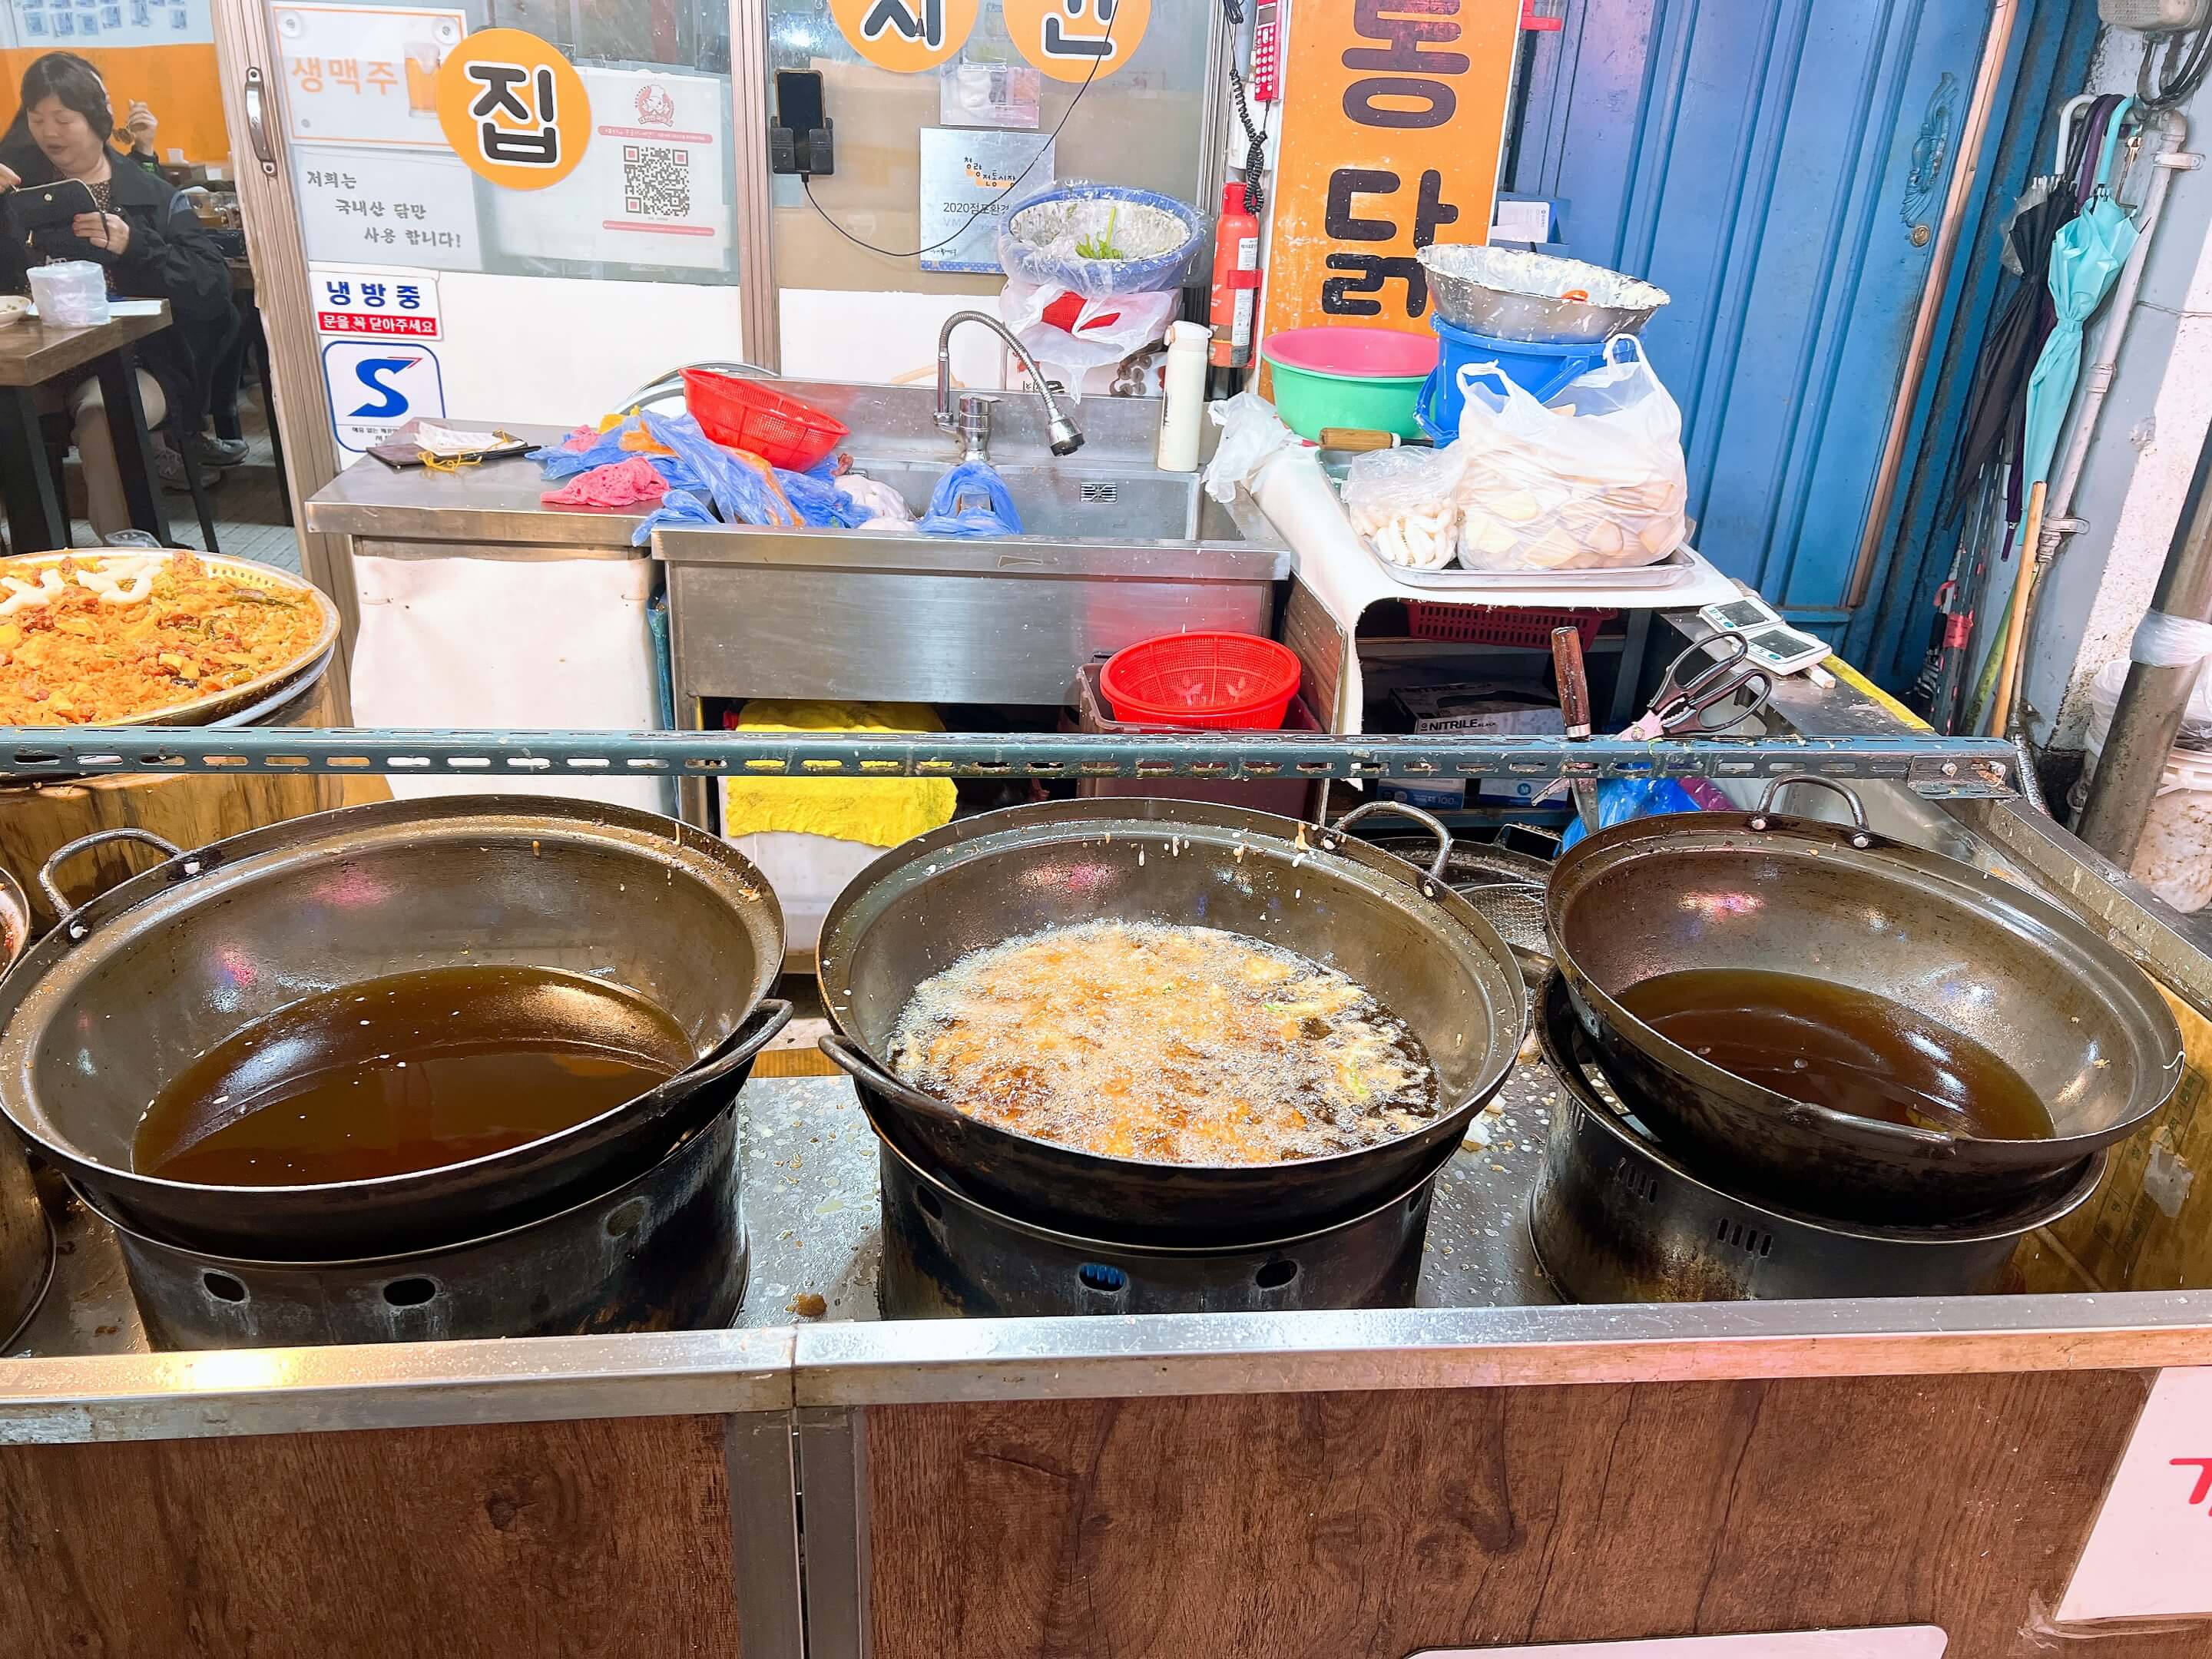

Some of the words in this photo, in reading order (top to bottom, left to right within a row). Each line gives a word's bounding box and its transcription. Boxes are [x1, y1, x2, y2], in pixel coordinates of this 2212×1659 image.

[292, 57, 399, 95] 생맥주
[467, 64, 560, 166] 집
[307, 171, 357, 189] 저희는
[335, 199, 386, 217] 국내산
[393, 203, 427, 220] 닭만
[364, 227, 396, 244] 사용
[405, 230, 461, 247] 합니다!
[323, 315, 349, 329] 문을
[353, 316, 366, 330] 꼭
[369, 318, 435, 333] 닫아주세요
[1429, 718, 1478, 731] NITRILE
